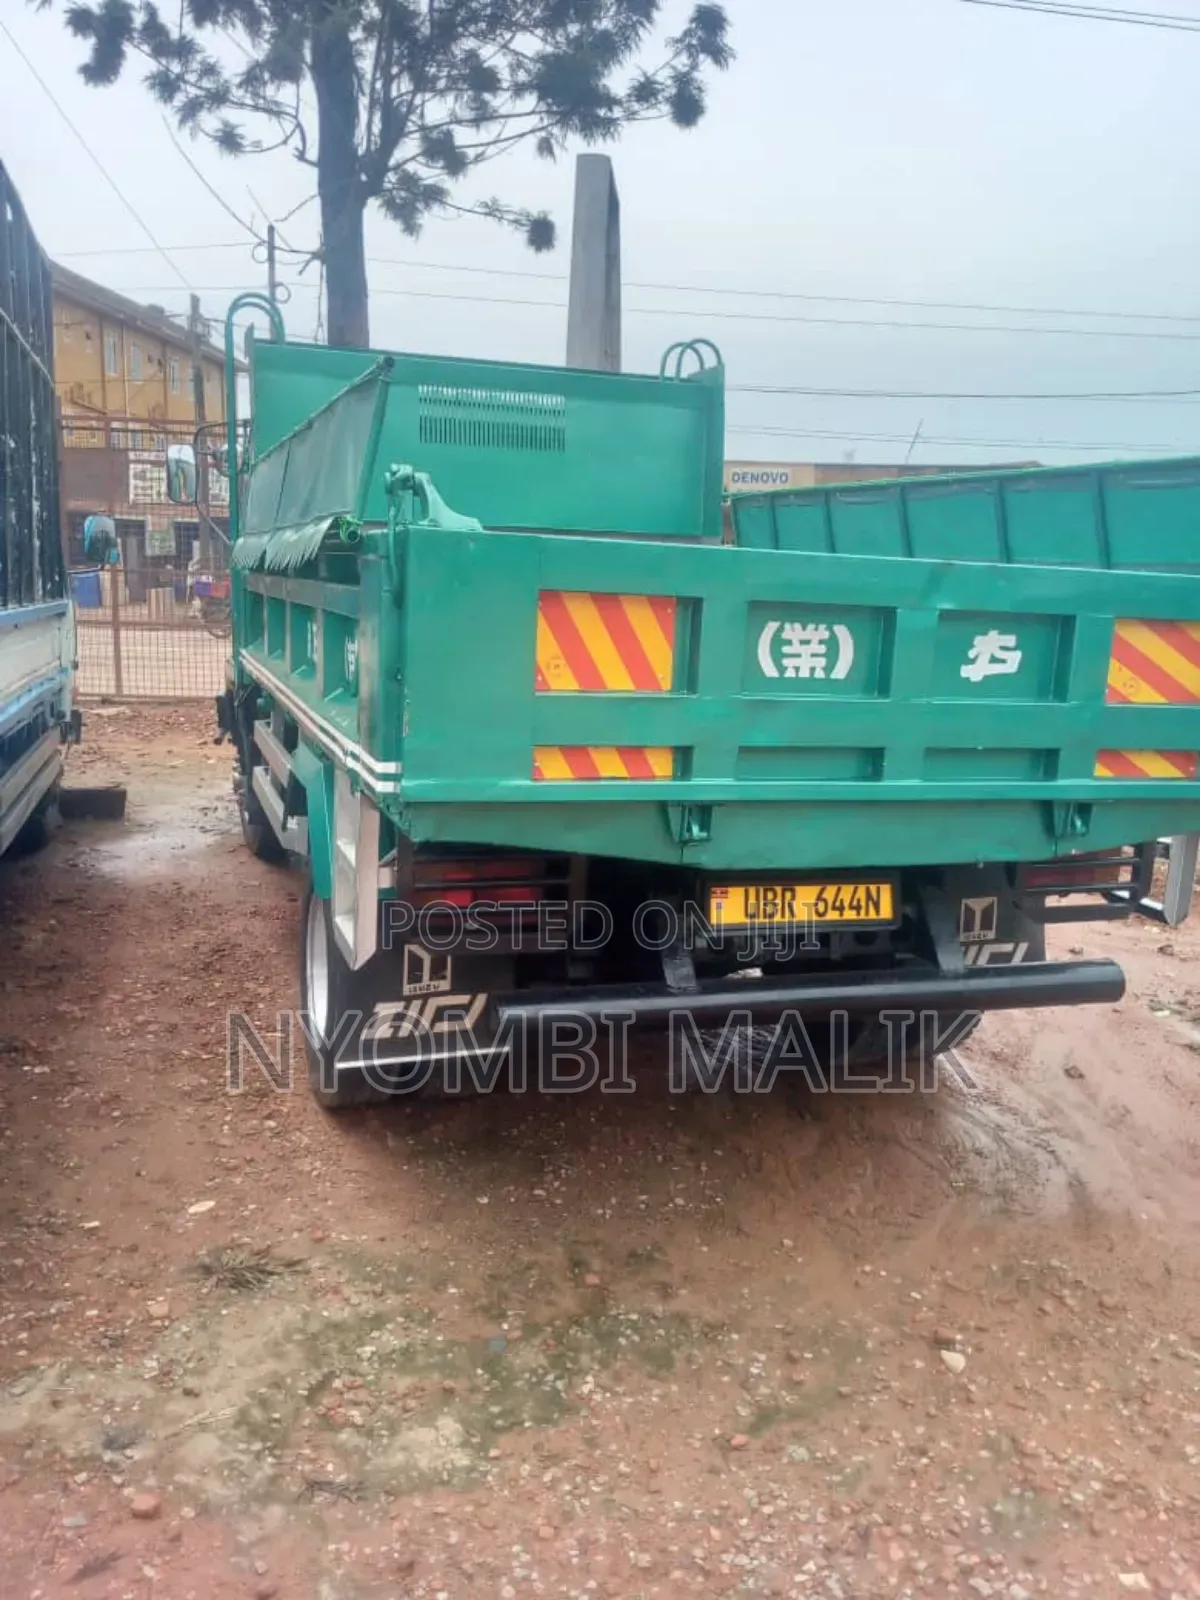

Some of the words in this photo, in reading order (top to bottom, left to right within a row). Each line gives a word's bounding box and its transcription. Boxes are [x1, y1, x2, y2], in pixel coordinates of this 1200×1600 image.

[731, 471, 789, 484] DENOVO
[743, 885, 797, 920] UBR
[814, 885, 882, 918] 644N
